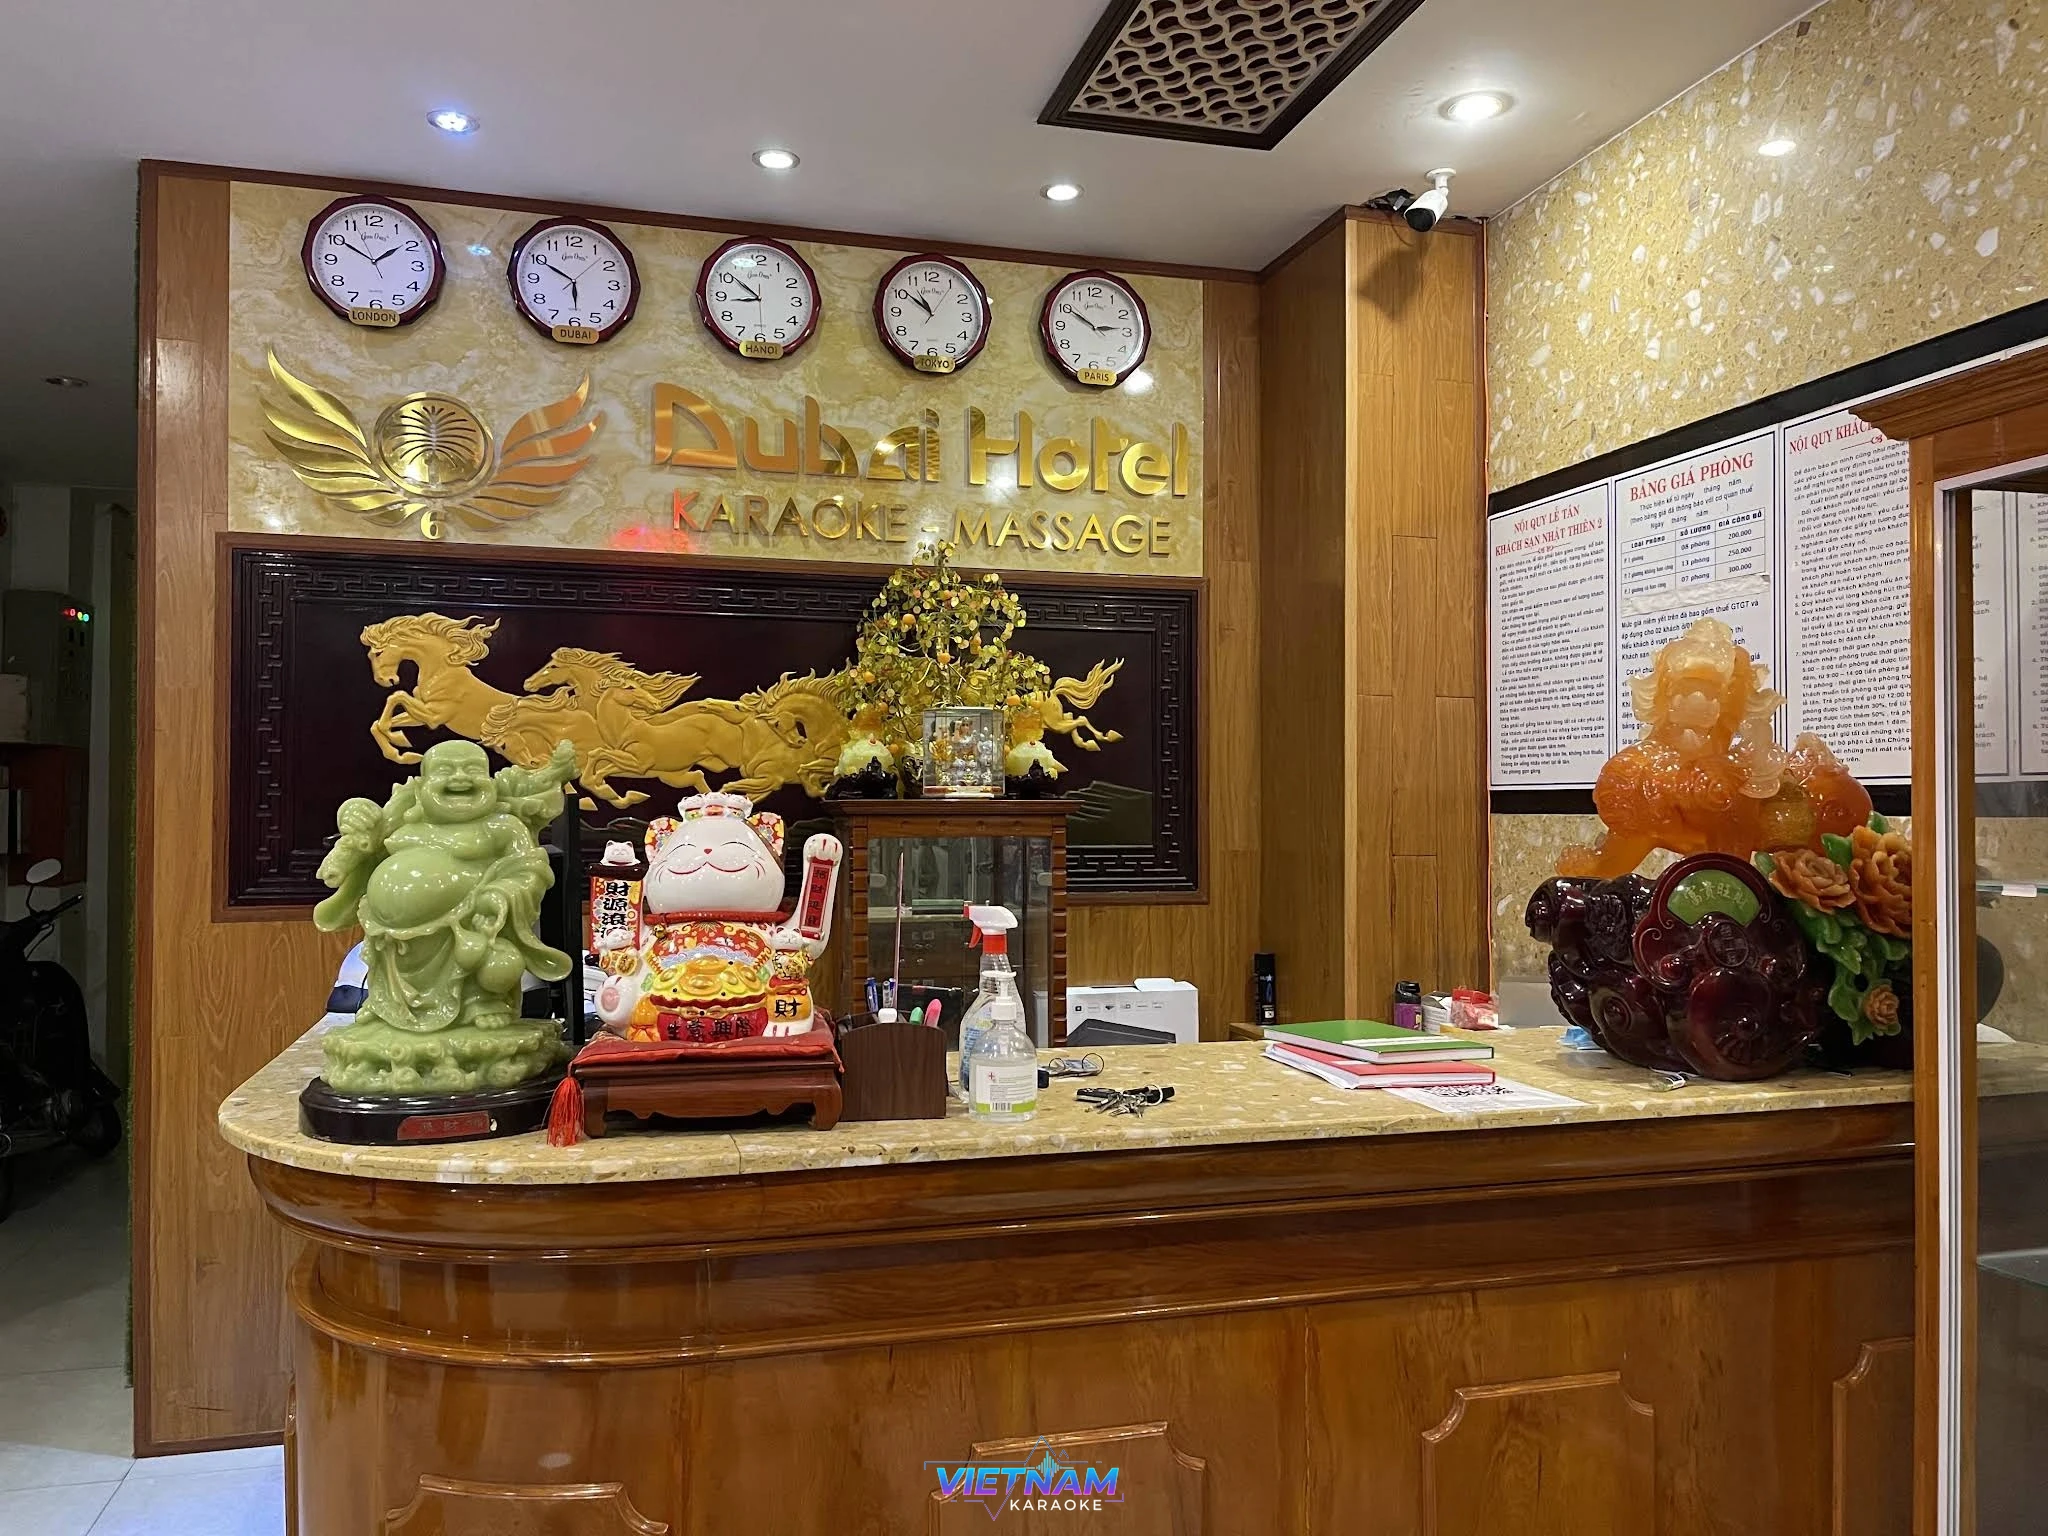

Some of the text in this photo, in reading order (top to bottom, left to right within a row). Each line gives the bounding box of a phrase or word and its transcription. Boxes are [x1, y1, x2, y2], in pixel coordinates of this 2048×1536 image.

[345, 220, 357, 231] 11
[364, 215, 384, 227] 12
[394, 224, 399, 235] 1
[328, 234, 345, 246] 10
[547, 240, 558, 251] 11
[565, 236, 583, 247] 12
[405, 240, 420, 252] 2
[593, 244, 597, 255] 1
[324, 254, 338, 265] 9
[531, 254, 547, 265] 10
[411, 261, 425, 272] 3
[603, 261, 616, 272] 2
[776, 262, 780, 273] 1
[331, 275, 345, 286] 8
[528, 273, 540, 284] 9
[719, 272, 734, 284] 10
[908, 276, 918, 287] 11
[924, 271, 940, 282] 12
[406, 281, 420, 292] 4
[608, 280, 620, 291] 3
[785, 278, 798, 288] 2
[949, 279, 952, 289] 1
[347, 291, 359, 303] 7
[715, 291, 727, 302] 9
[894, 288, 908, 300] 10
[1072, 291, 1082, 302] 11
[1087, 286, 1102, 298] 12
[392, 295, 405, 306] 5
[533, 293, 546, 304] 8
[790, 296, 803, 307] 3
[957, 294, 968, 304] 2
[1110, 294, 1114, 305] 1
[370, 300, 383, 310] 6
[603, 300, 616, 310] 4
[1059, 303, 1072, 314] 10
[352, 311, 397, 322] LONDON
[548, 309, 559, 320] 7
[721, 311, 733, 321] 8
[891, 306, 902, 317] 9
[1118, 309, 1129, 320] 2
[569, 317, 581, 327] 6
[589, 313, 601, 323] 5
[786, 316, 799, 325] 4
[961, 312, 973, 323] 3
[735, 325, 746, 336] 7
[896, 326, 907, 336] 8
[1055, 320, 1066, 331] 9
[560, 329, 591, 339] DUBAI
[755, 333, 766, 342] 6
[773, 329, 785, 339] 5
[957, 330, 968, 340] 4
[1122, 327, 1132, 337] 3
[745, 344, 778, 355] HANOI
[909, 341, 919, 350] 7
[945, 343, 956, 353] 5
[1060, 339, 1070, 349] 8
[927, 347, 938, 357] 6
[921, 358, 950, 369] TOKYO
[1072, 353, 1081, 363] 7
[1106, 356, 1117, 367] 5
[1089, 361, 1099, 370] 6
[1084, 371, 1109, 382] PARIS
[655, 382, 1188, 496] Dubai Hotel
[1811, 429, 1832, 449] QUY
[1630, 452, 1754, 502] BẢNG GIÁ PHÒNG
[672, 488, 908, 542] KARAOKE
[953, 511, 1172, 555] MASSAGE
[1531, 514, 1547, 530] QUY
[1597, 518, 1603, 529] 2
[1728, 529, 1752, 540] 200.000
[1728, 546, 1752, 557] 250.000
[1681, 575, 1689, 583] 07
[1728, 563, 1752, 573] 300.000
[1688, 610, 1700, 618] bao
[1730, 600, 1750, 610] GTGT
[1663, 624, 1680, 633] khách
[775, 998, 801, 1017] 財
